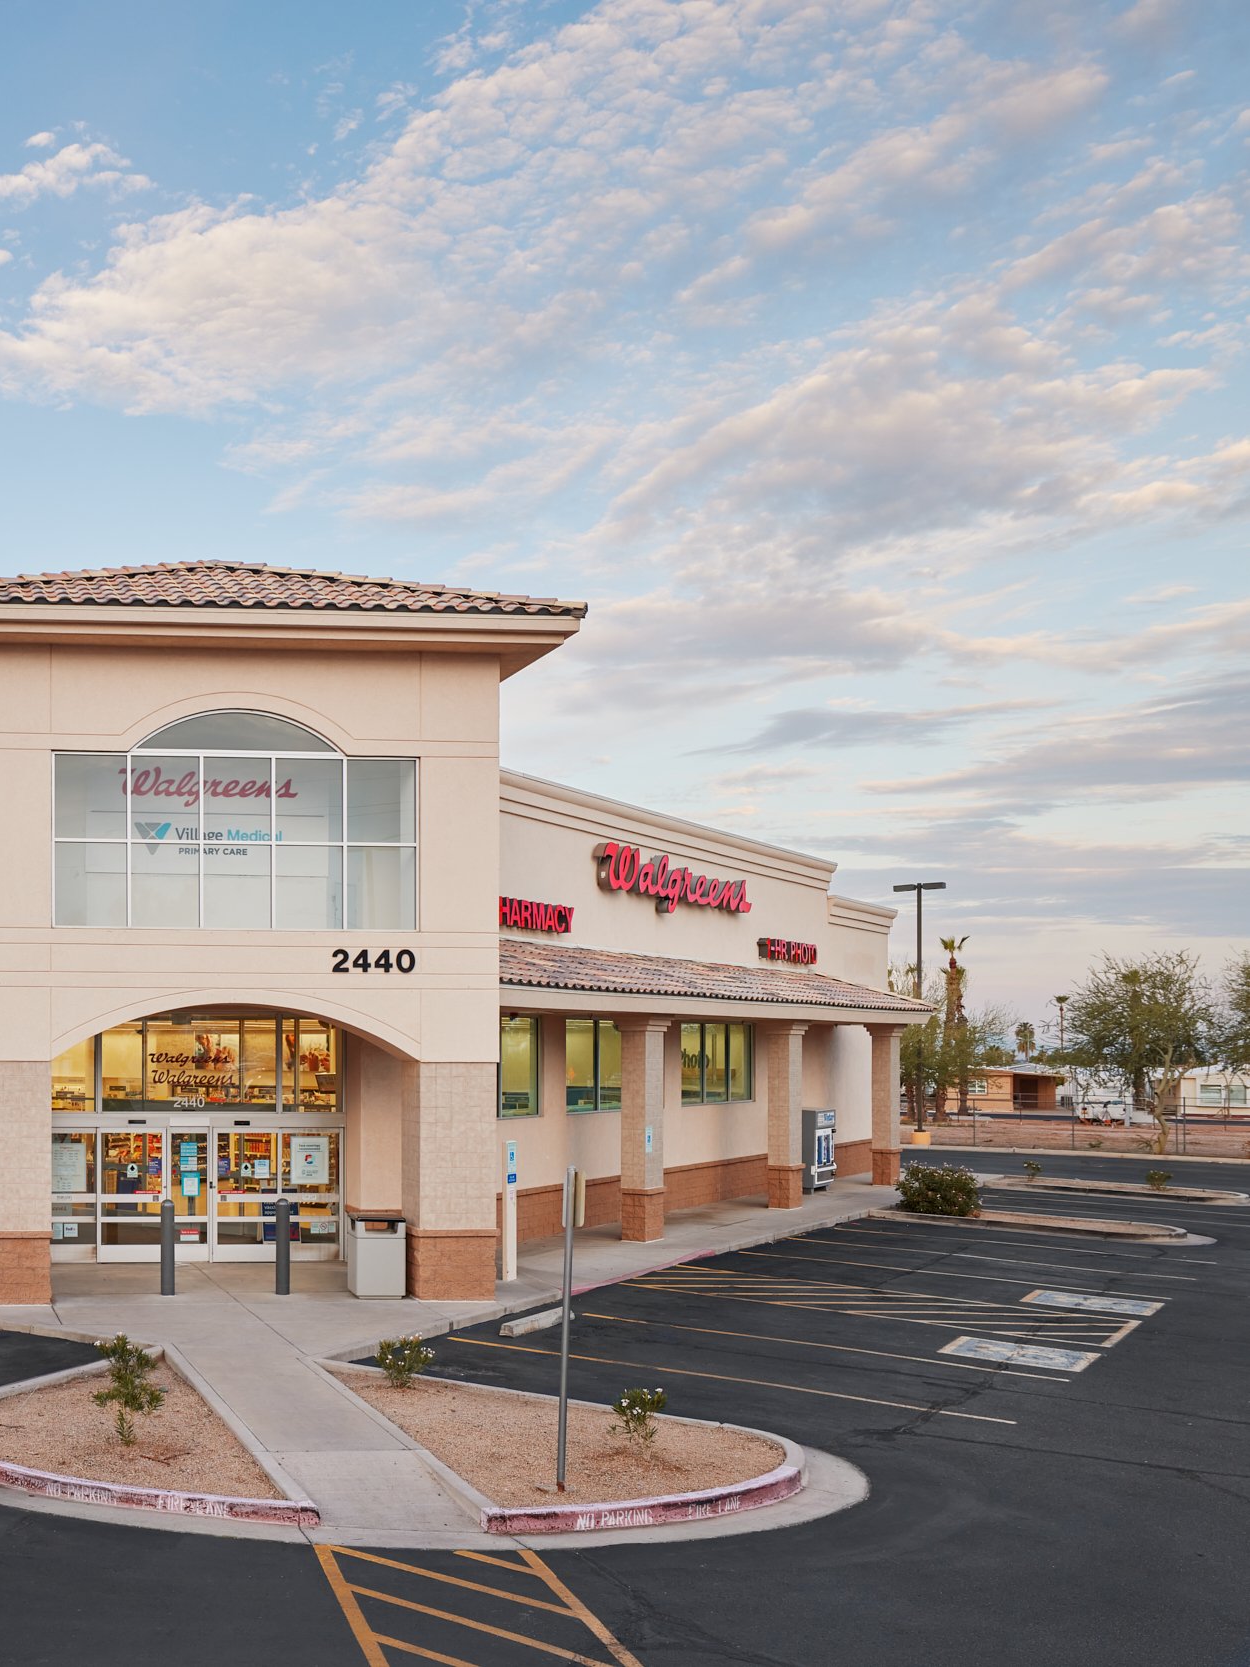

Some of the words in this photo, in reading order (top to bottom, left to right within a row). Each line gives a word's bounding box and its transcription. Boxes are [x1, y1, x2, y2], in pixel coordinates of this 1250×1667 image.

[118, 766, 298, 807] Walgreens
[178, 847, 220, 856] PRIMARY
[223, 848, 248, 856] CARE
[596, 841, 752, 913] Walgreens
[499, 896, 574, 933] HARMACY
[331, 948, 416, 974] 2440
[765, 938, 788, 960] 1-HR
[790, 941, 817, 965] PHOTO
[148, 1052, 231, 1067] Walgreens
[152, 1069, 236, 1087] Walgreens
[173, 1096, 205, 1108] 2440
[575, 1513, 596, 1531] NO
[600, 1508, 654, 1527] PARKING
